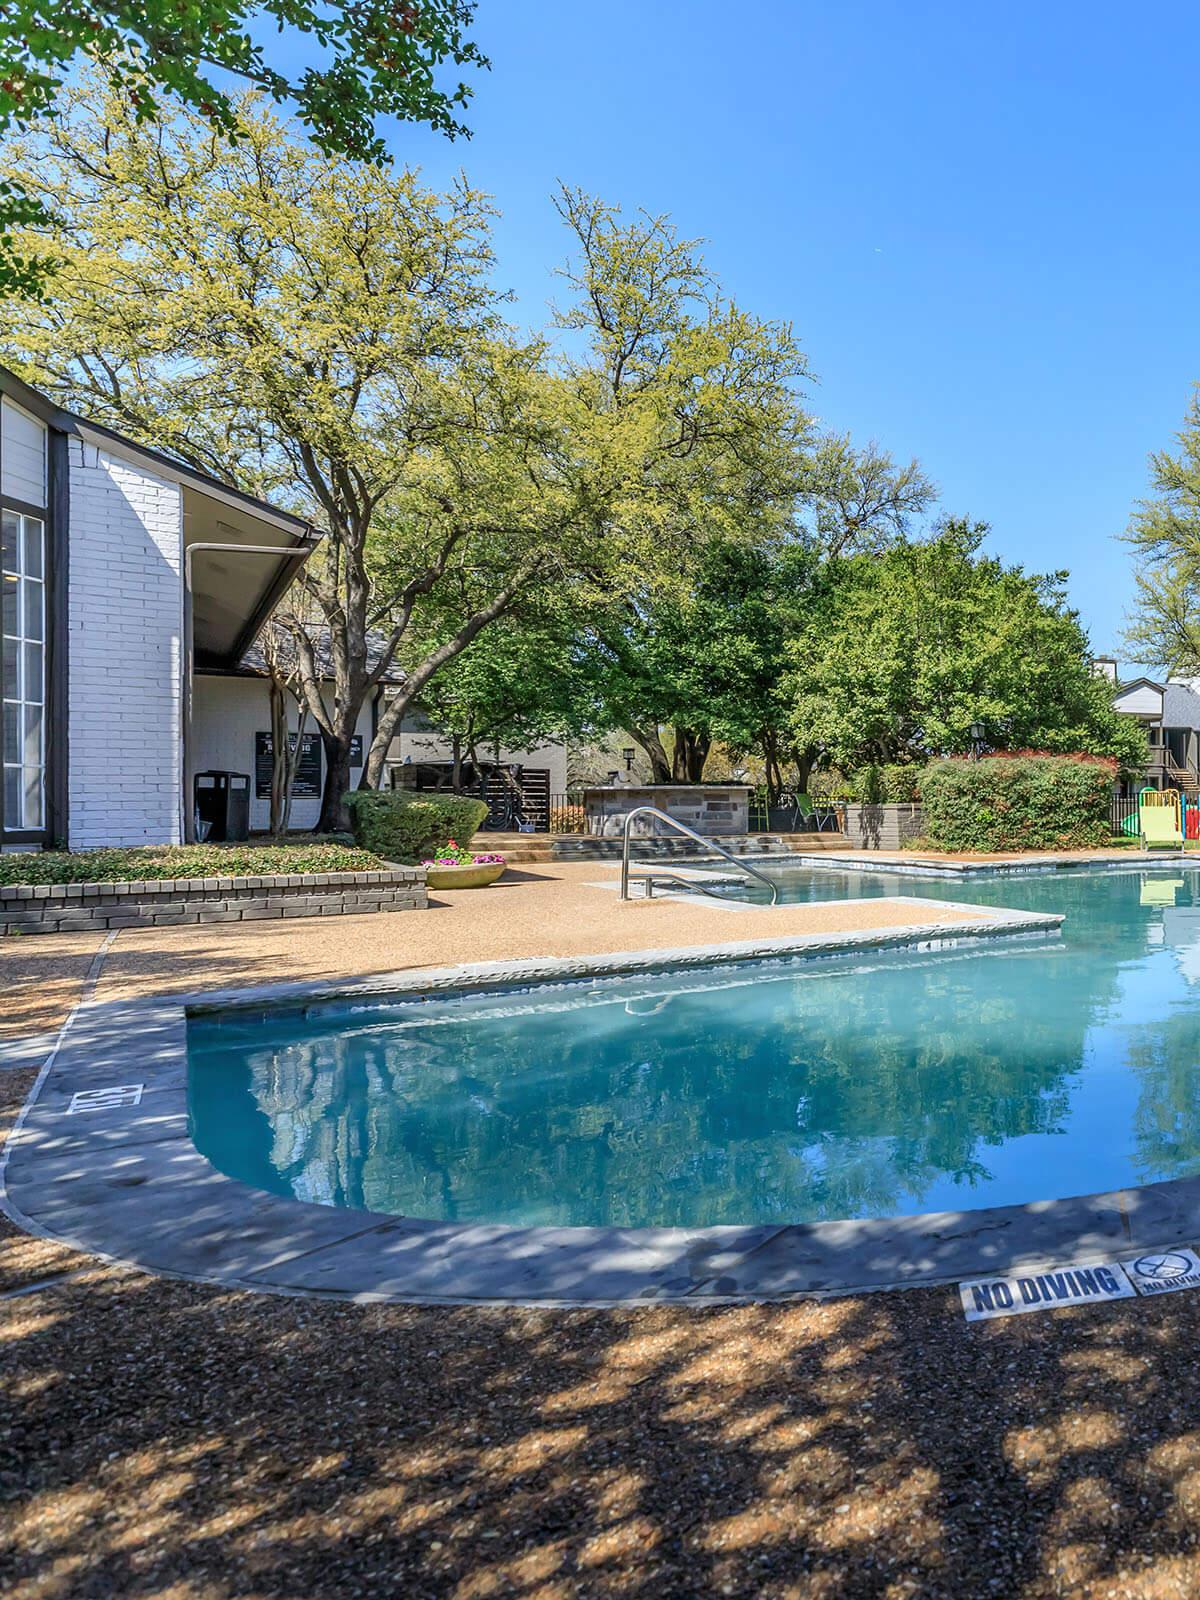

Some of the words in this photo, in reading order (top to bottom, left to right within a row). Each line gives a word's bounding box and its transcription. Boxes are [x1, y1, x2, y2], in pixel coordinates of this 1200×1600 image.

[971, 1282, 1015, 1312] NO
[1016, 1267, 1121, 1305] DIVING
[1143, 1281, 1163, 1292] NO
